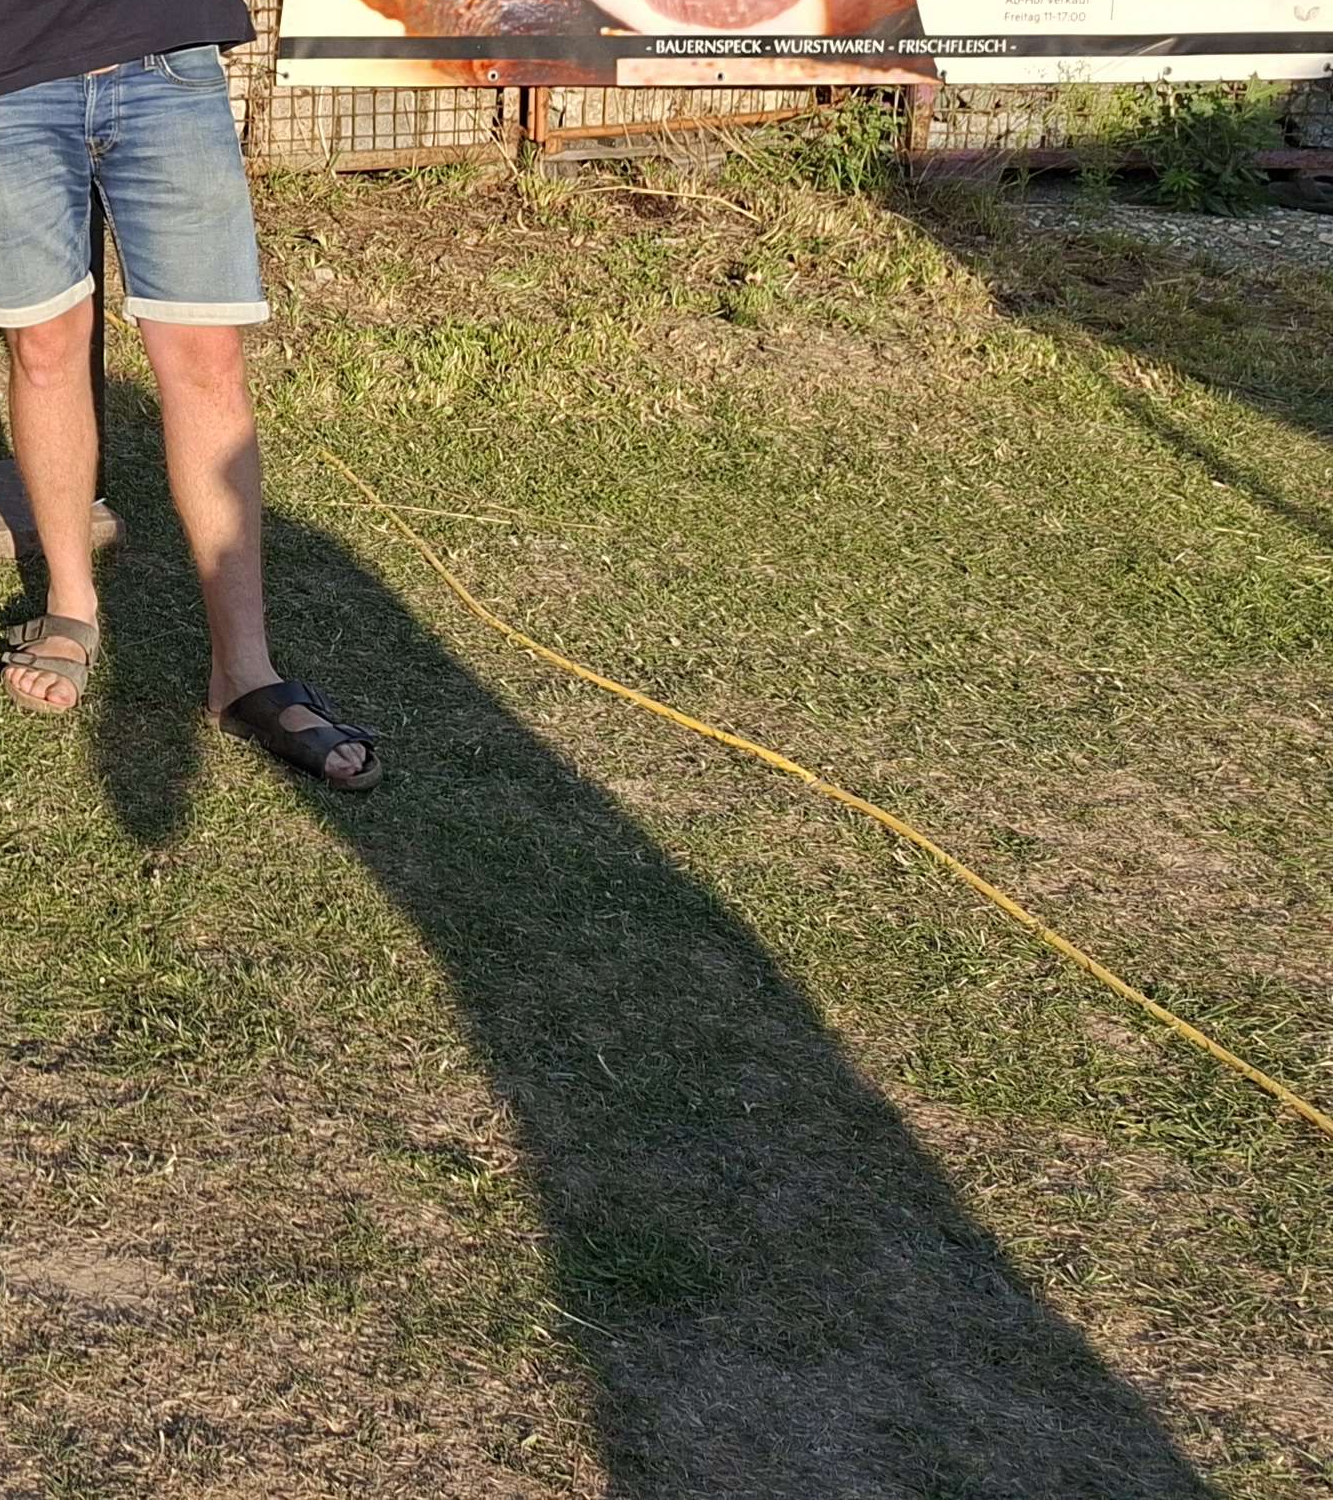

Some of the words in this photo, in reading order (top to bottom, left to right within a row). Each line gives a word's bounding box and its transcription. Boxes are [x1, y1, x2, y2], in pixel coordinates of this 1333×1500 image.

[1004, 11, 1041, 23] Freitag
[656, 40, 763, 55] BAUERNSPECK
[774, 39, 885, 55] WURSTWAREN
[898, 39, 1007, 54] FRISCHFLEISCH
